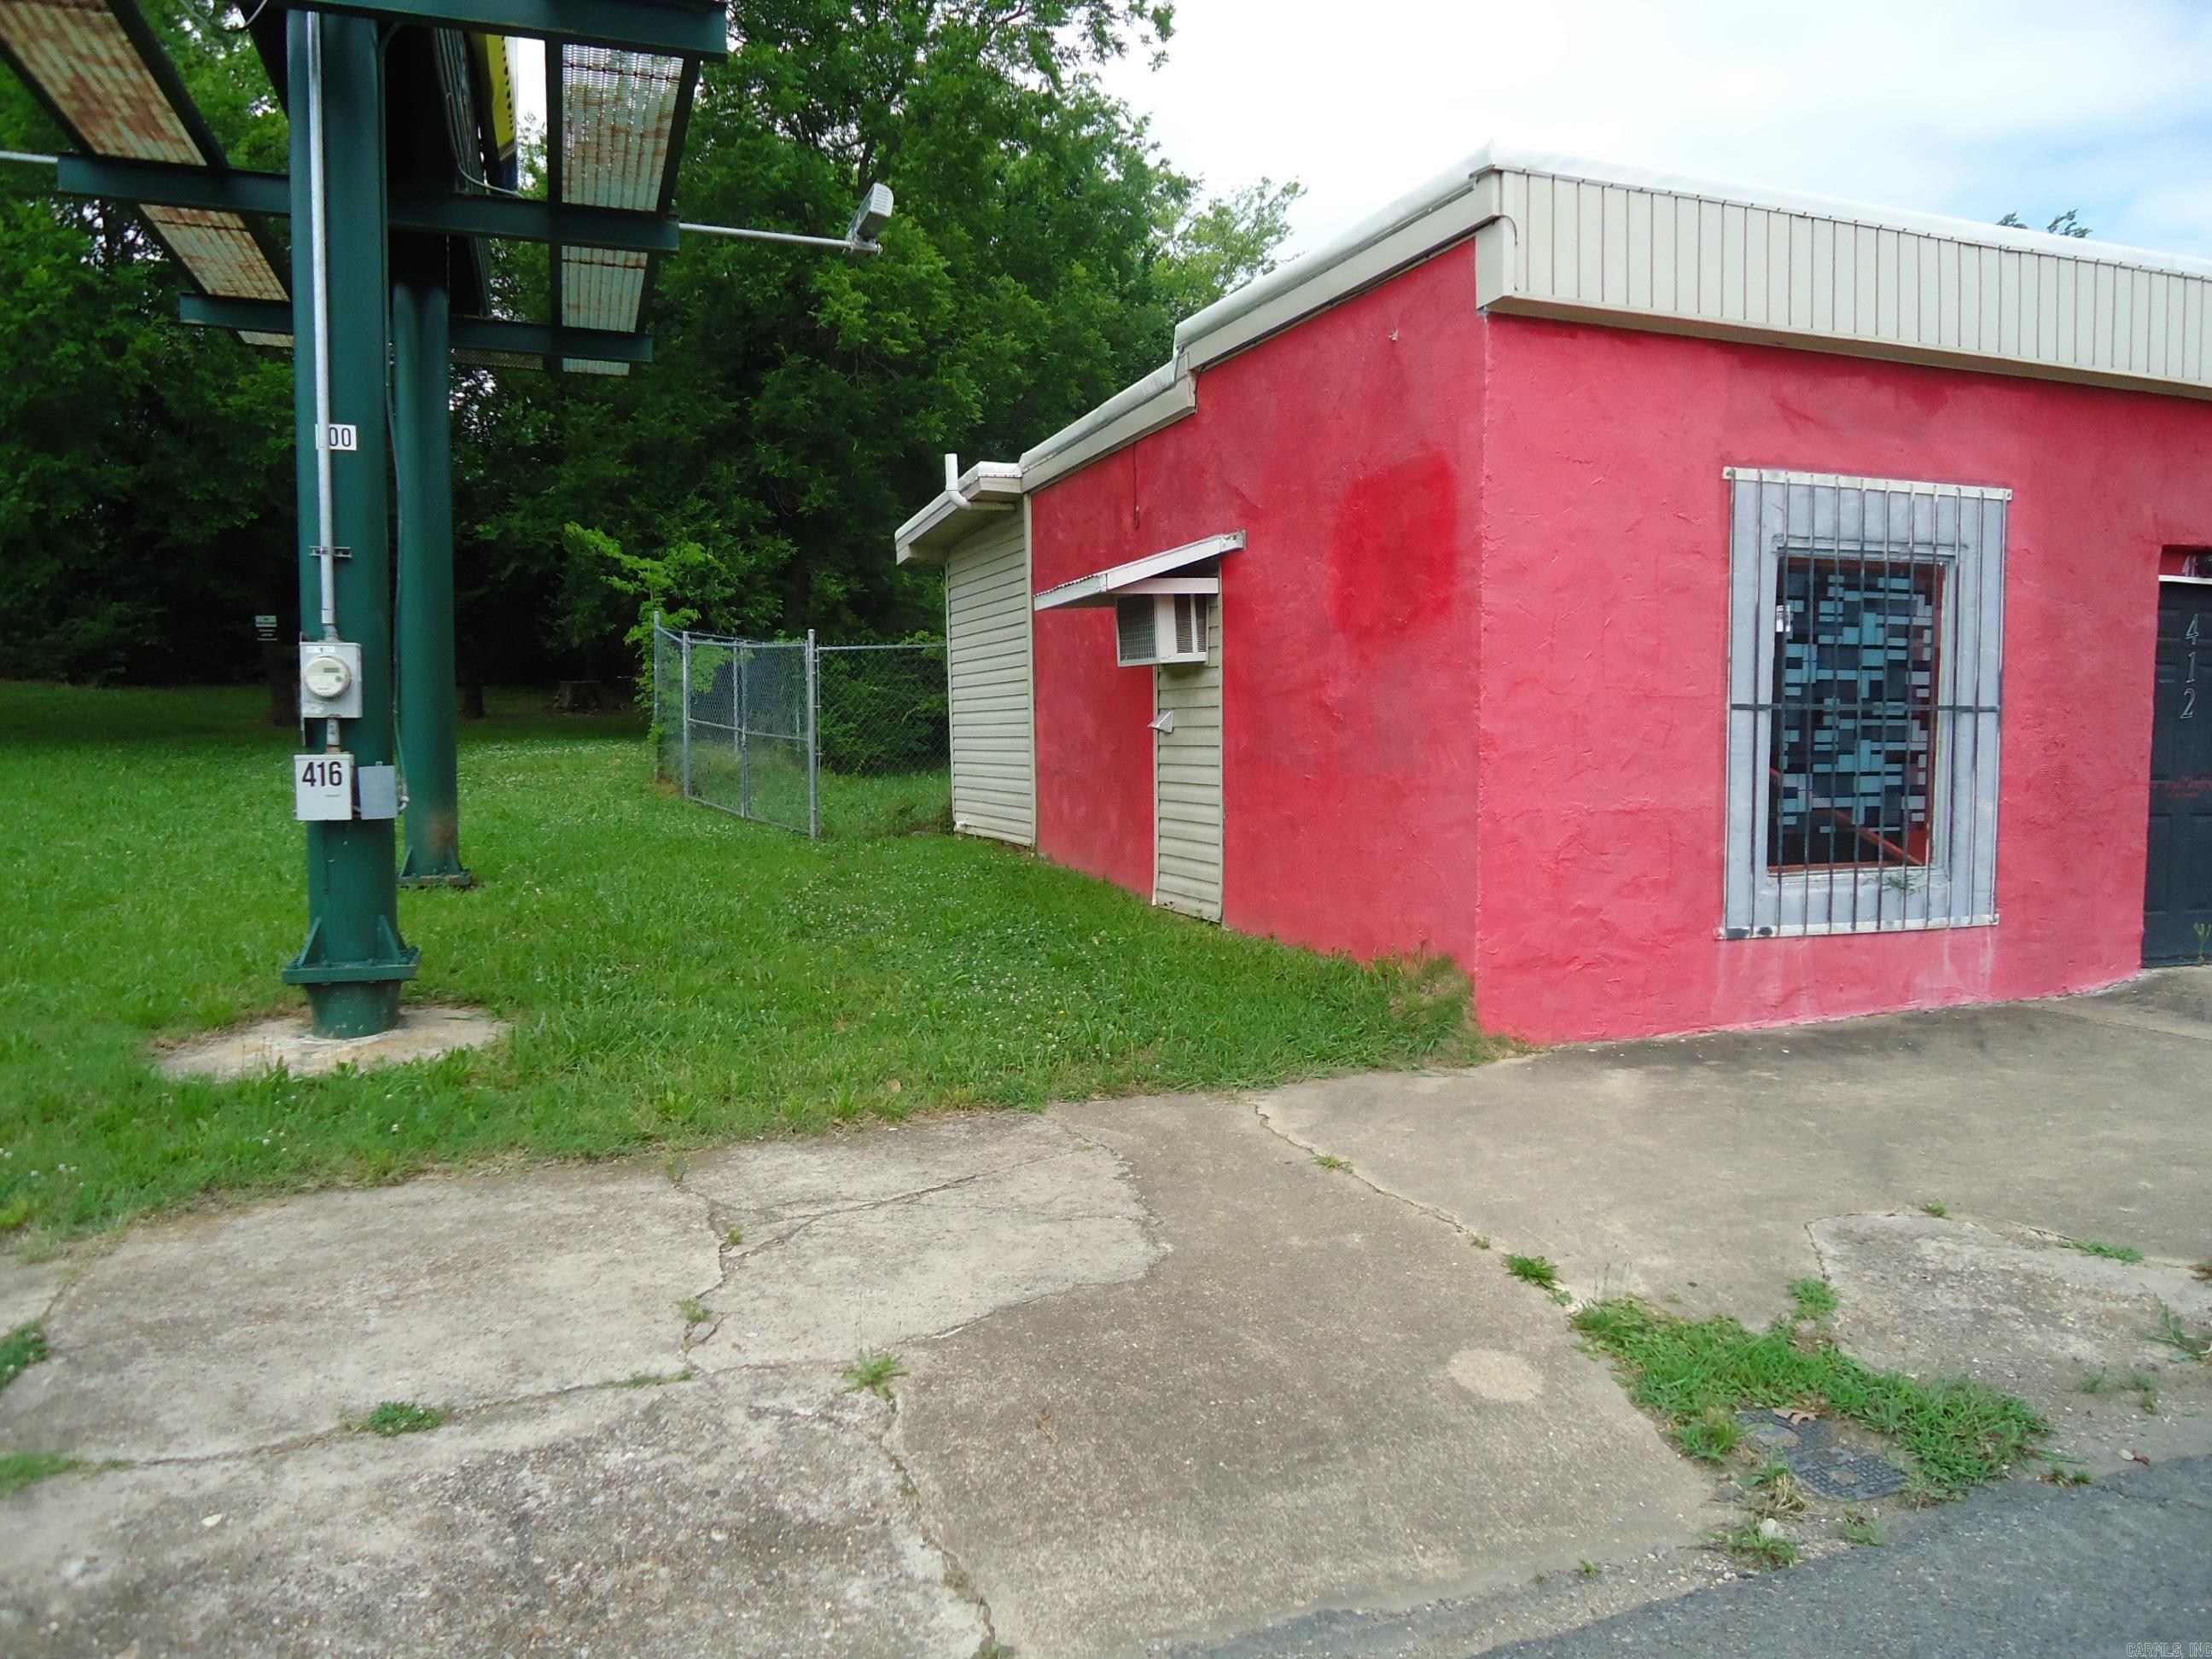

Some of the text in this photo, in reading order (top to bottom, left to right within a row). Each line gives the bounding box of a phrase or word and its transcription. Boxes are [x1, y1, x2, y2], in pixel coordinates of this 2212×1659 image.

[329, 427, 352, 447] 00
[2180, 613, 2199, 719] 412
[302, 761, 342, 787] 416
